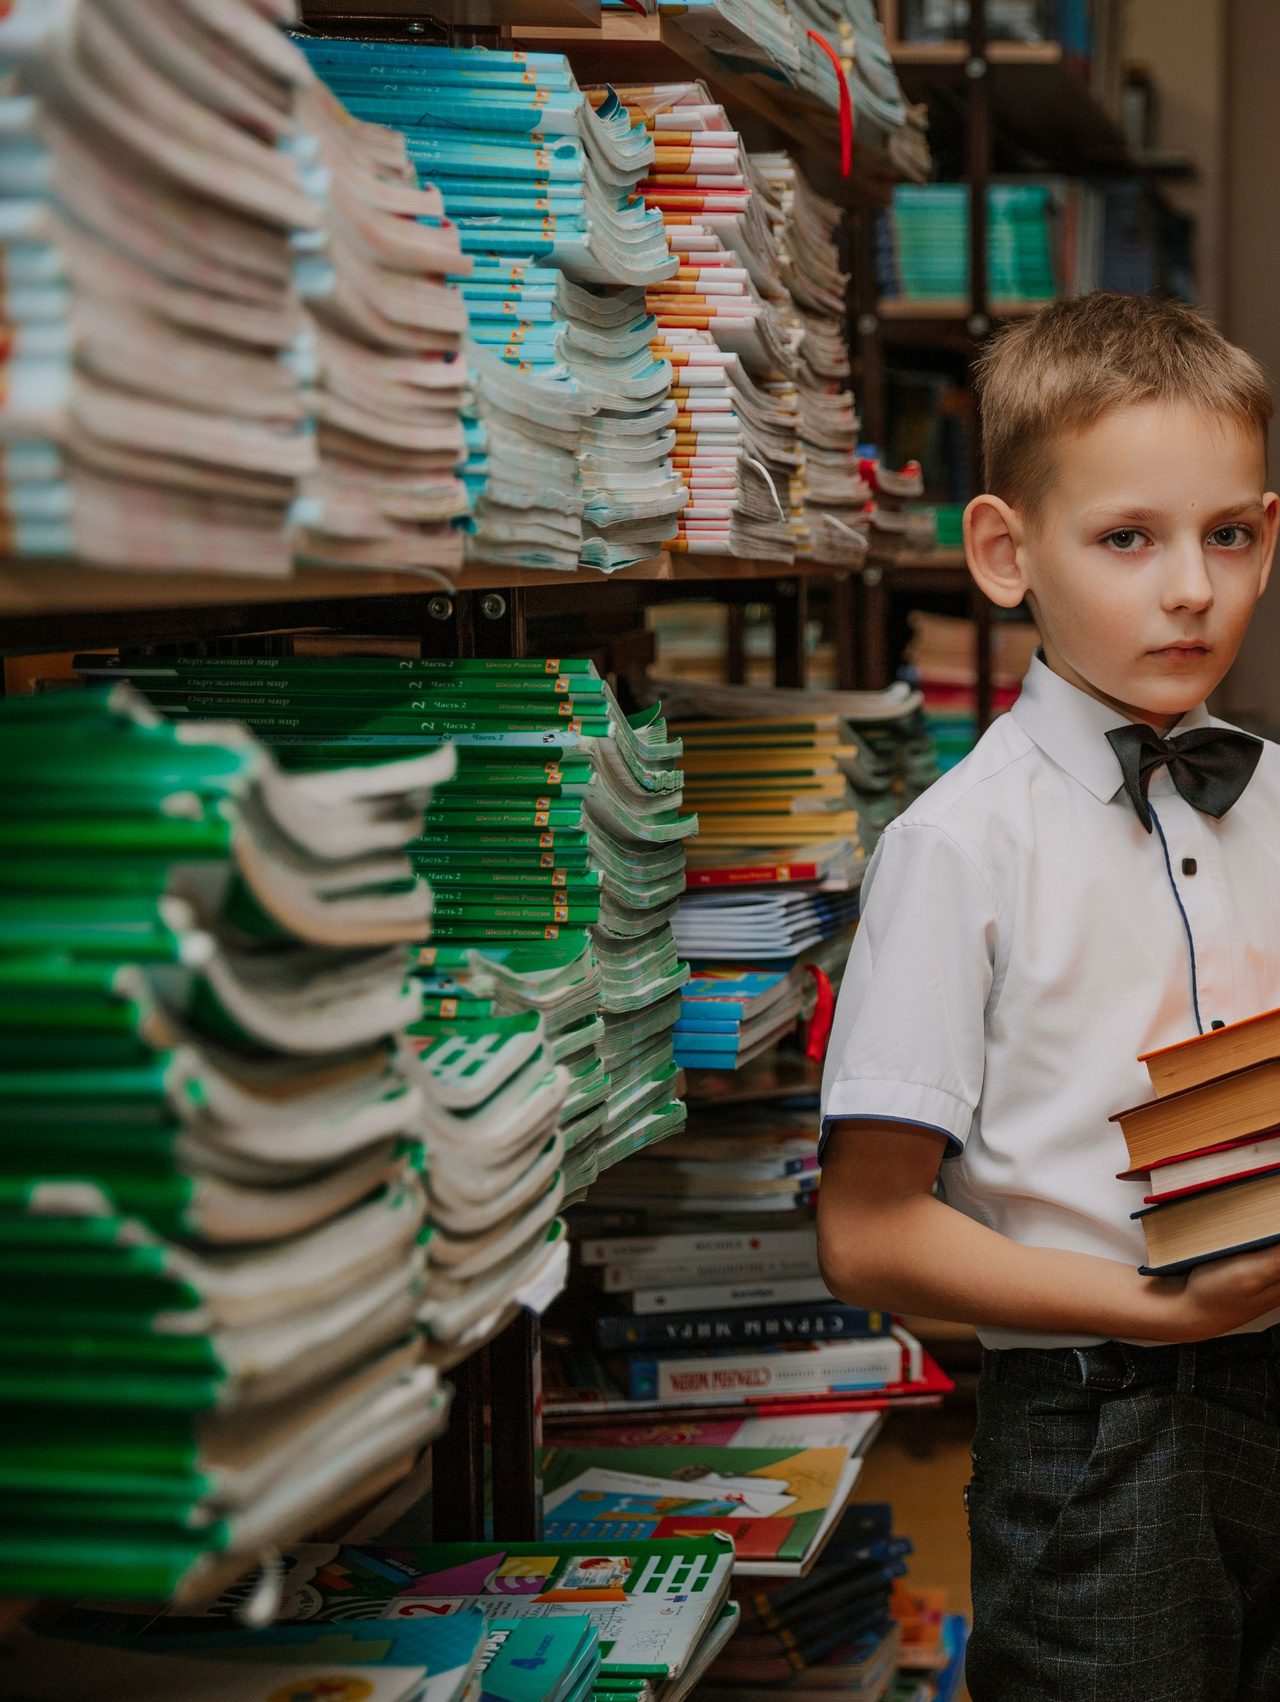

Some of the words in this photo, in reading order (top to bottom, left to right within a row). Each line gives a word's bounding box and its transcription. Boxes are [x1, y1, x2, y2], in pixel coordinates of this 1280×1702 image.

[256, 659, 279, 667] мир
[188, 679, 263, 688] Окружающий
[188, 695, 265, 704] Окружающий
[268, 698, 290, 706] мир
[277, 718, 300, 726] мир
[429, 872, 454, 880] Часть
[712, 1366, 772, 1390] СТРАНЫ
